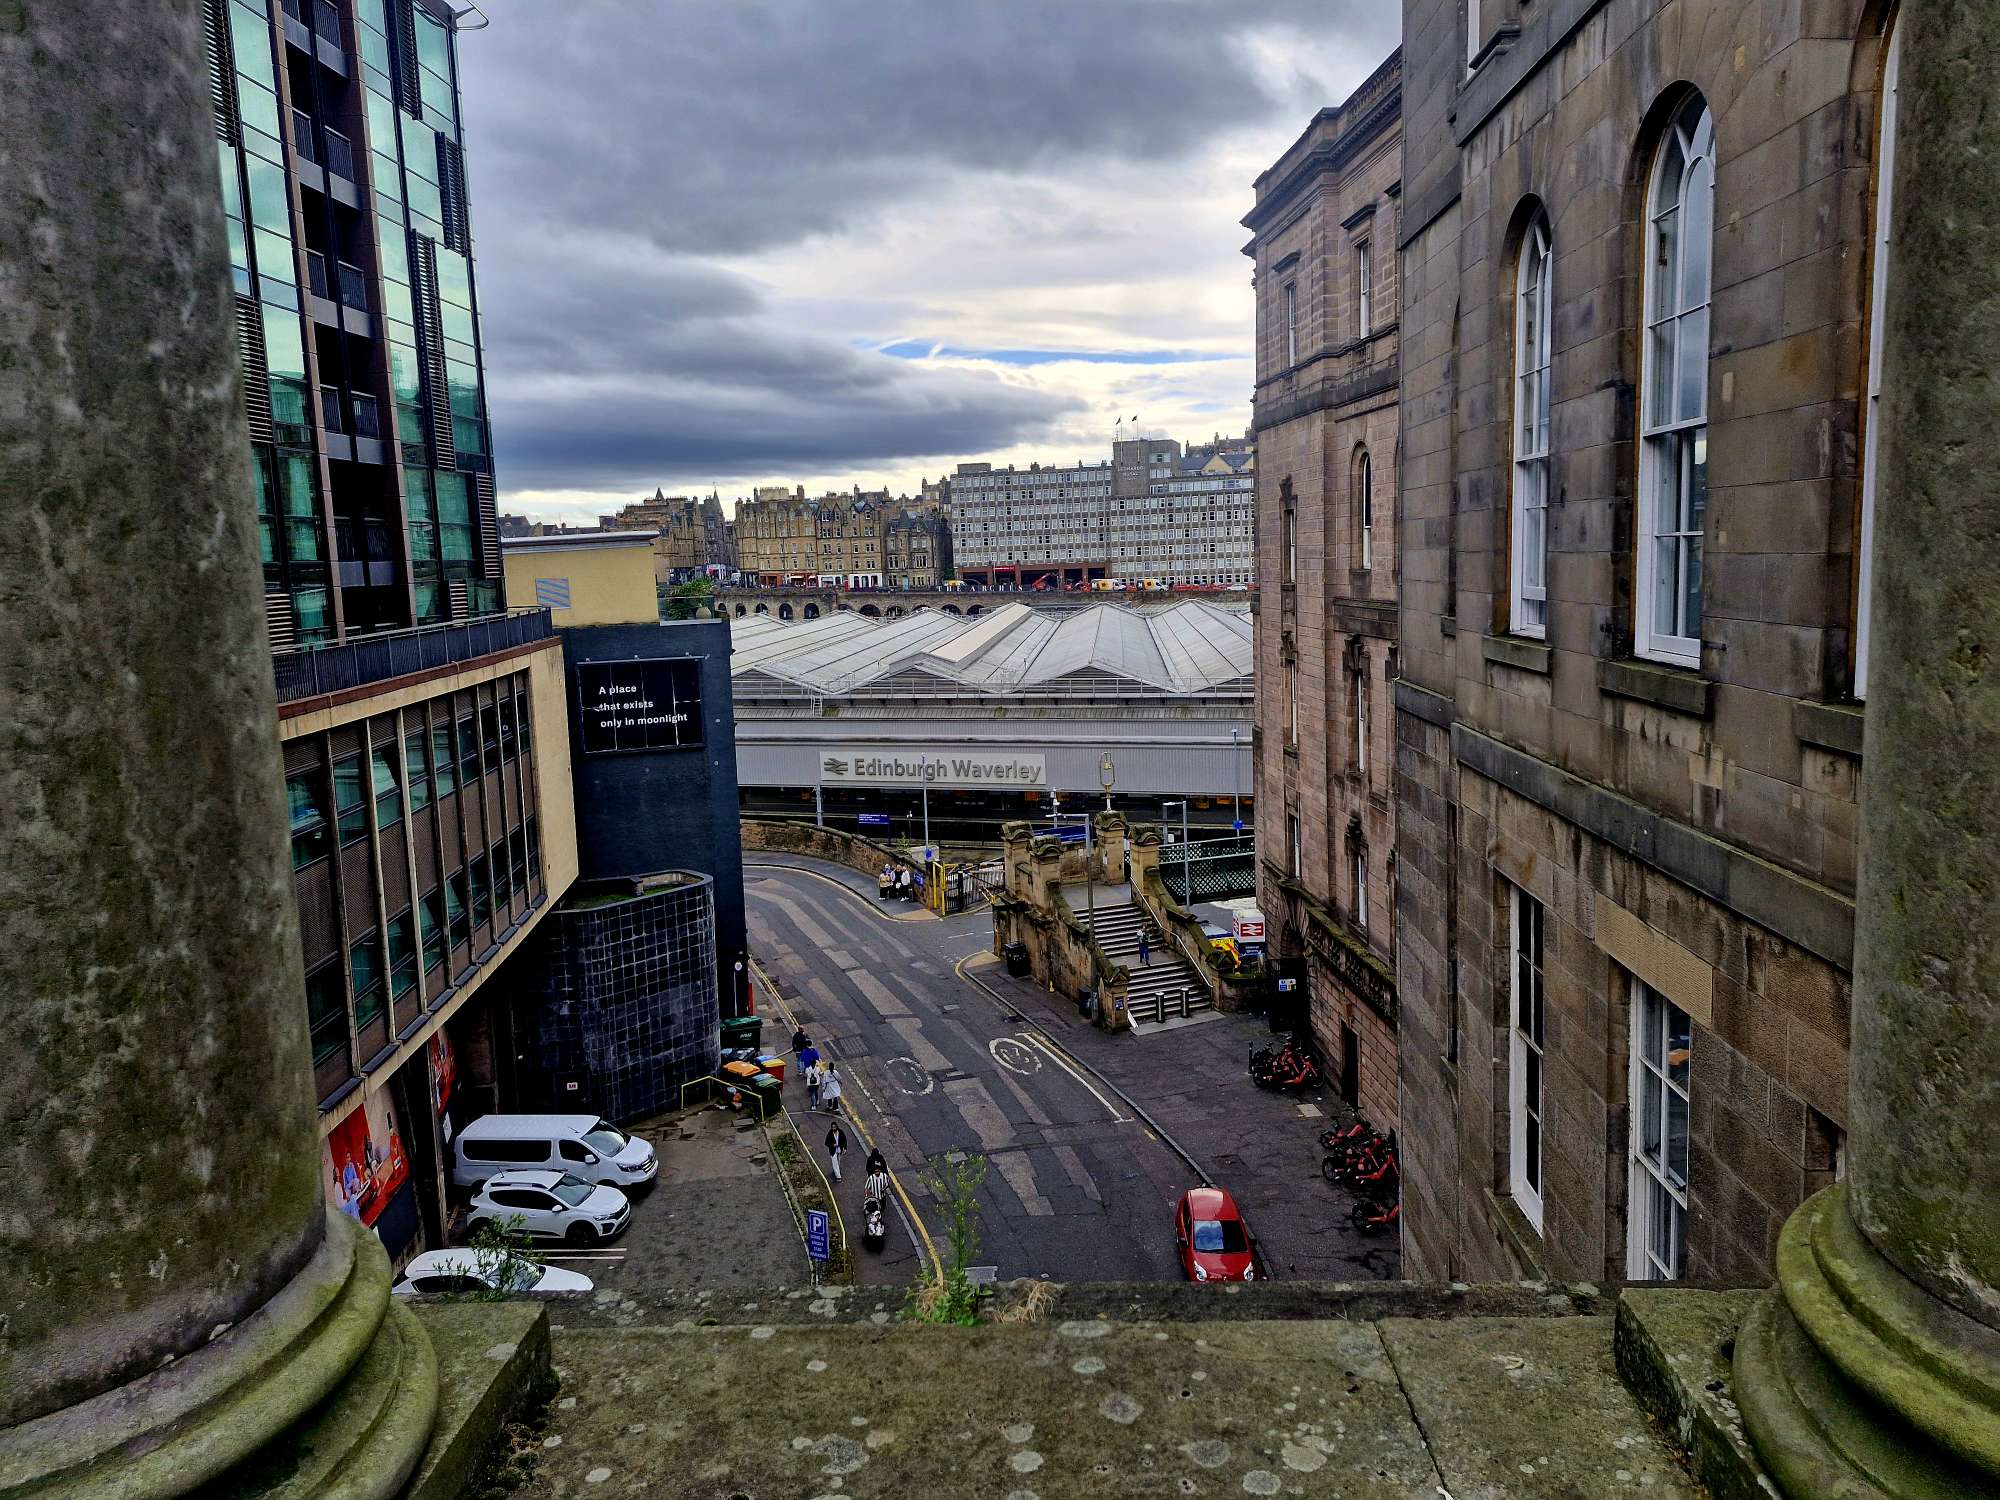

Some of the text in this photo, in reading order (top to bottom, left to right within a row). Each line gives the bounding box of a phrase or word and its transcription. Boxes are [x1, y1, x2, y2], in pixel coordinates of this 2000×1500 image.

[598, 685, 637, 695] A place
[598, 700, 654, 711] that exists
[600, 713, 688, 728] only in moonlight
[854, 758, 1041, 783] Edinburgh Waverley
[812, 1217, 822, 1231] P
